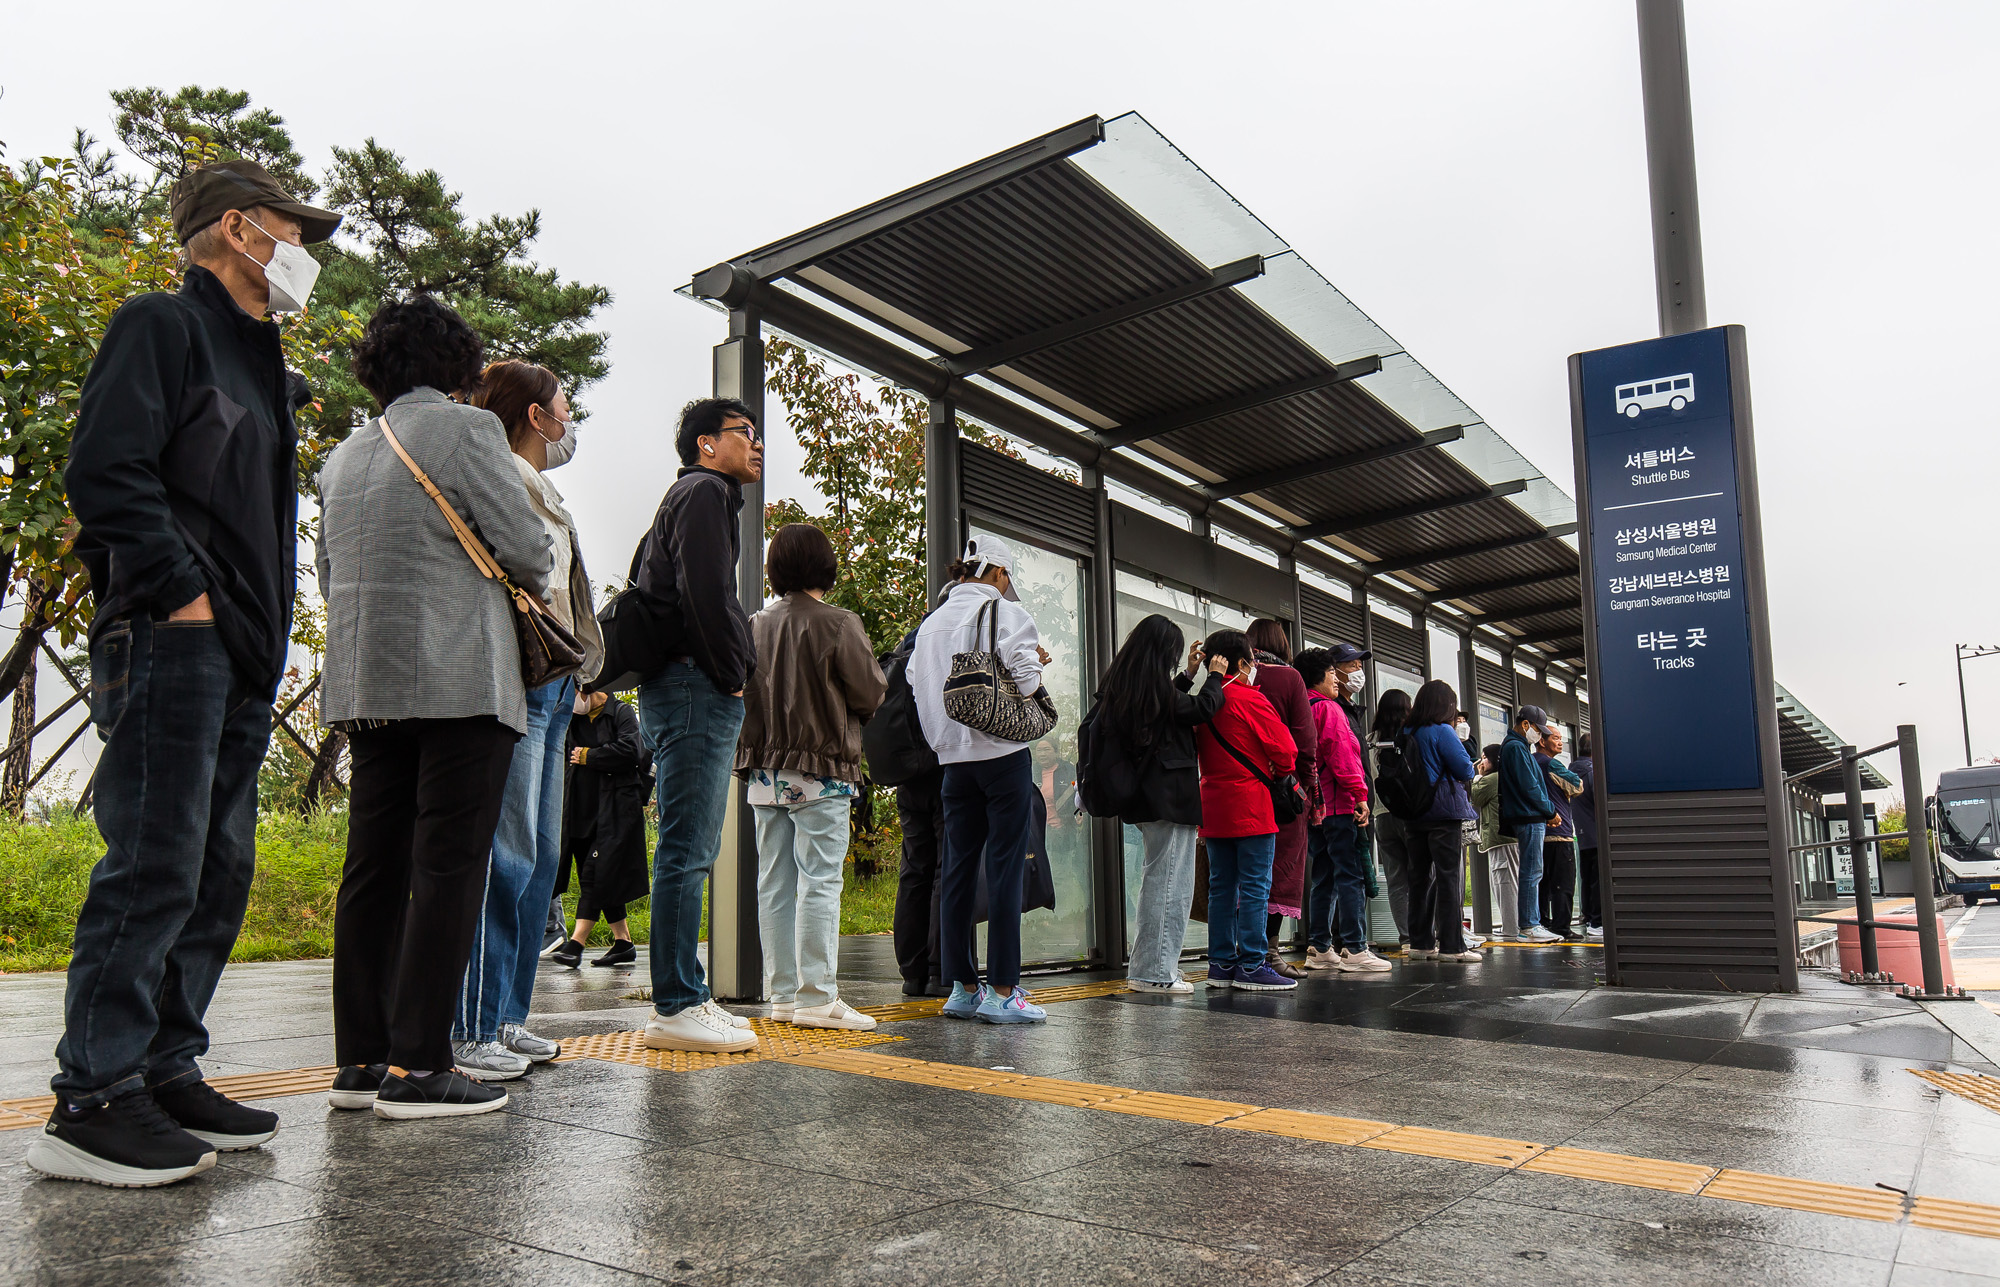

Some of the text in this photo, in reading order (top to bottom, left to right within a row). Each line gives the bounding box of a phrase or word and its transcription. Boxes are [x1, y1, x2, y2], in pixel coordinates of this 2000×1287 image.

[1624, 446, 1696, 469] 셔틀버스
[1631, 469, 1691, 486] Shuttle Bus
[1614, 517, 1717, 546] 삼성서울병원
[1616, 541, 1717, 563] Samsung Medical Center
[1608, 565, 1730, 594] 강남세브란스병원
[1610, 588, 1731, 611] Gangnam Severance Hospital
[1637, 627, 1708, 651] 타는 곳
[1653, 655, 1695, 670] Tracks
